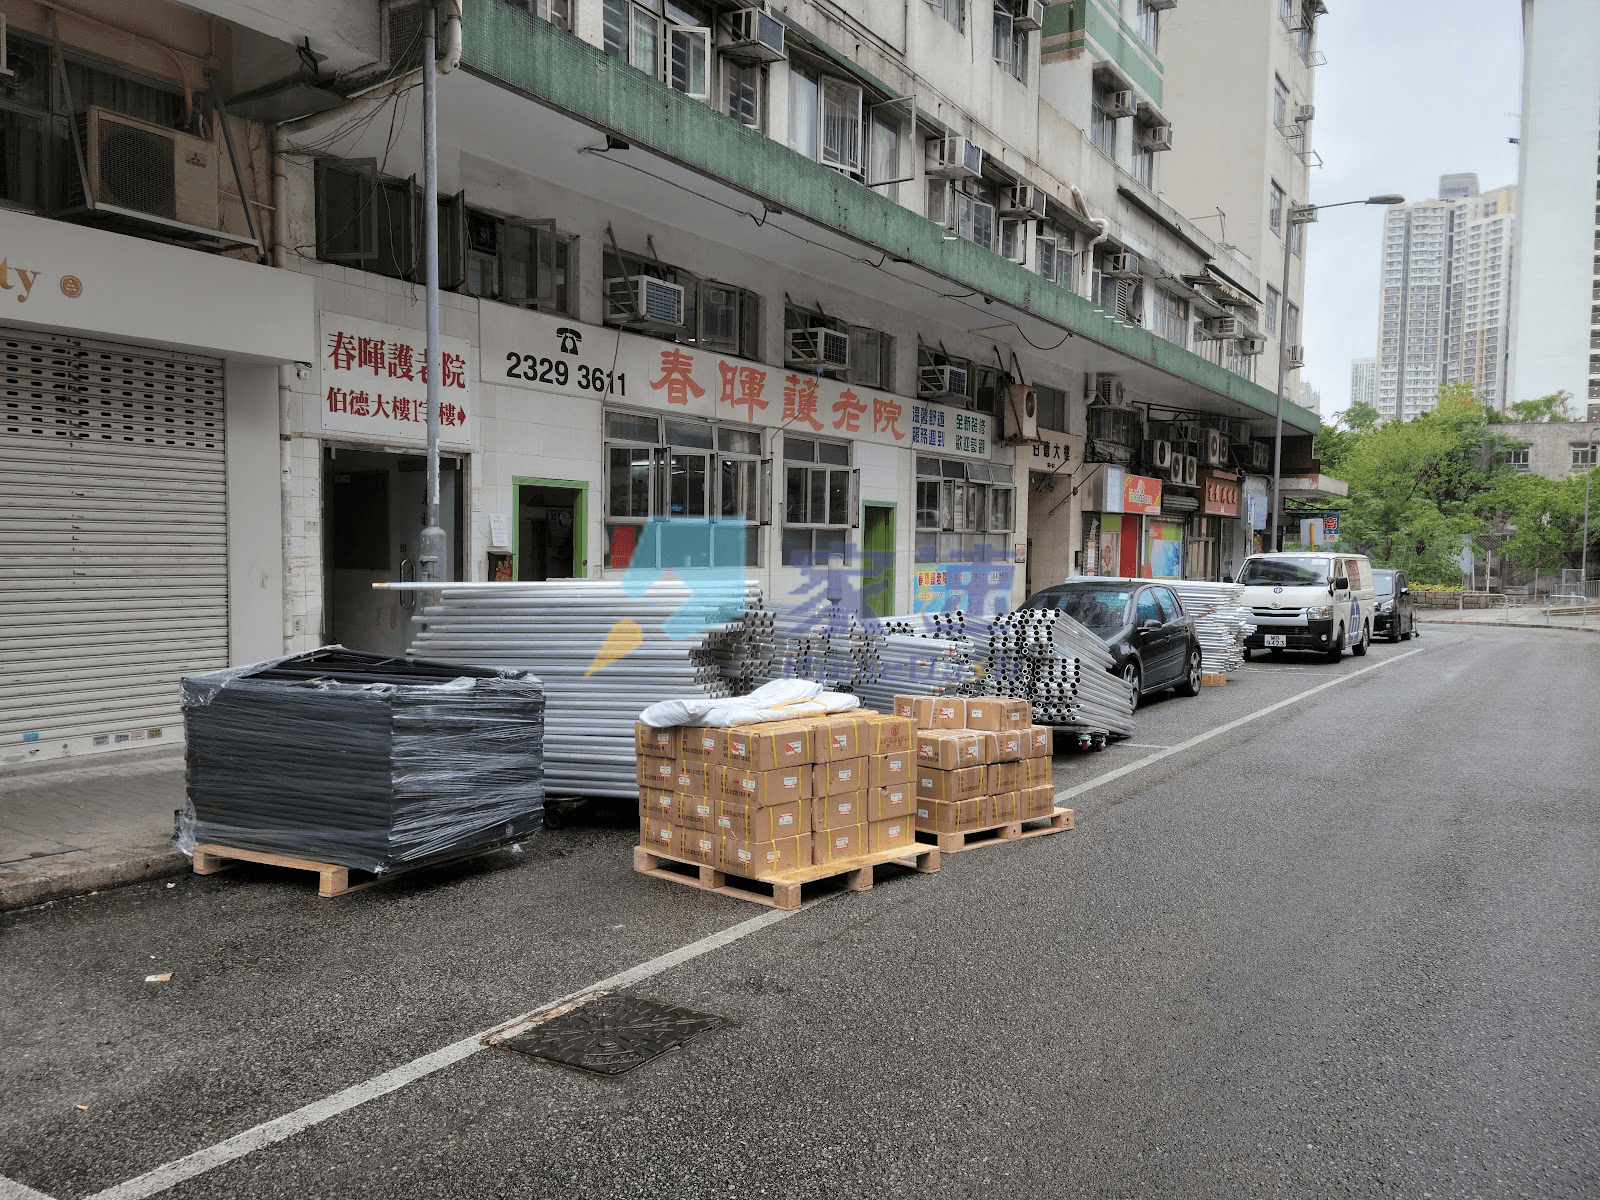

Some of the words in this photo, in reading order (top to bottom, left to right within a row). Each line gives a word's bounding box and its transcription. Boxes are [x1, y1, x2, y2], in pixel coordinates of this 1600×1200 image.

[506, 351, 569, 385] 2329
[577, 364, 626, 396] 3611
[650, 347, 906, 441] 春暉護老院
